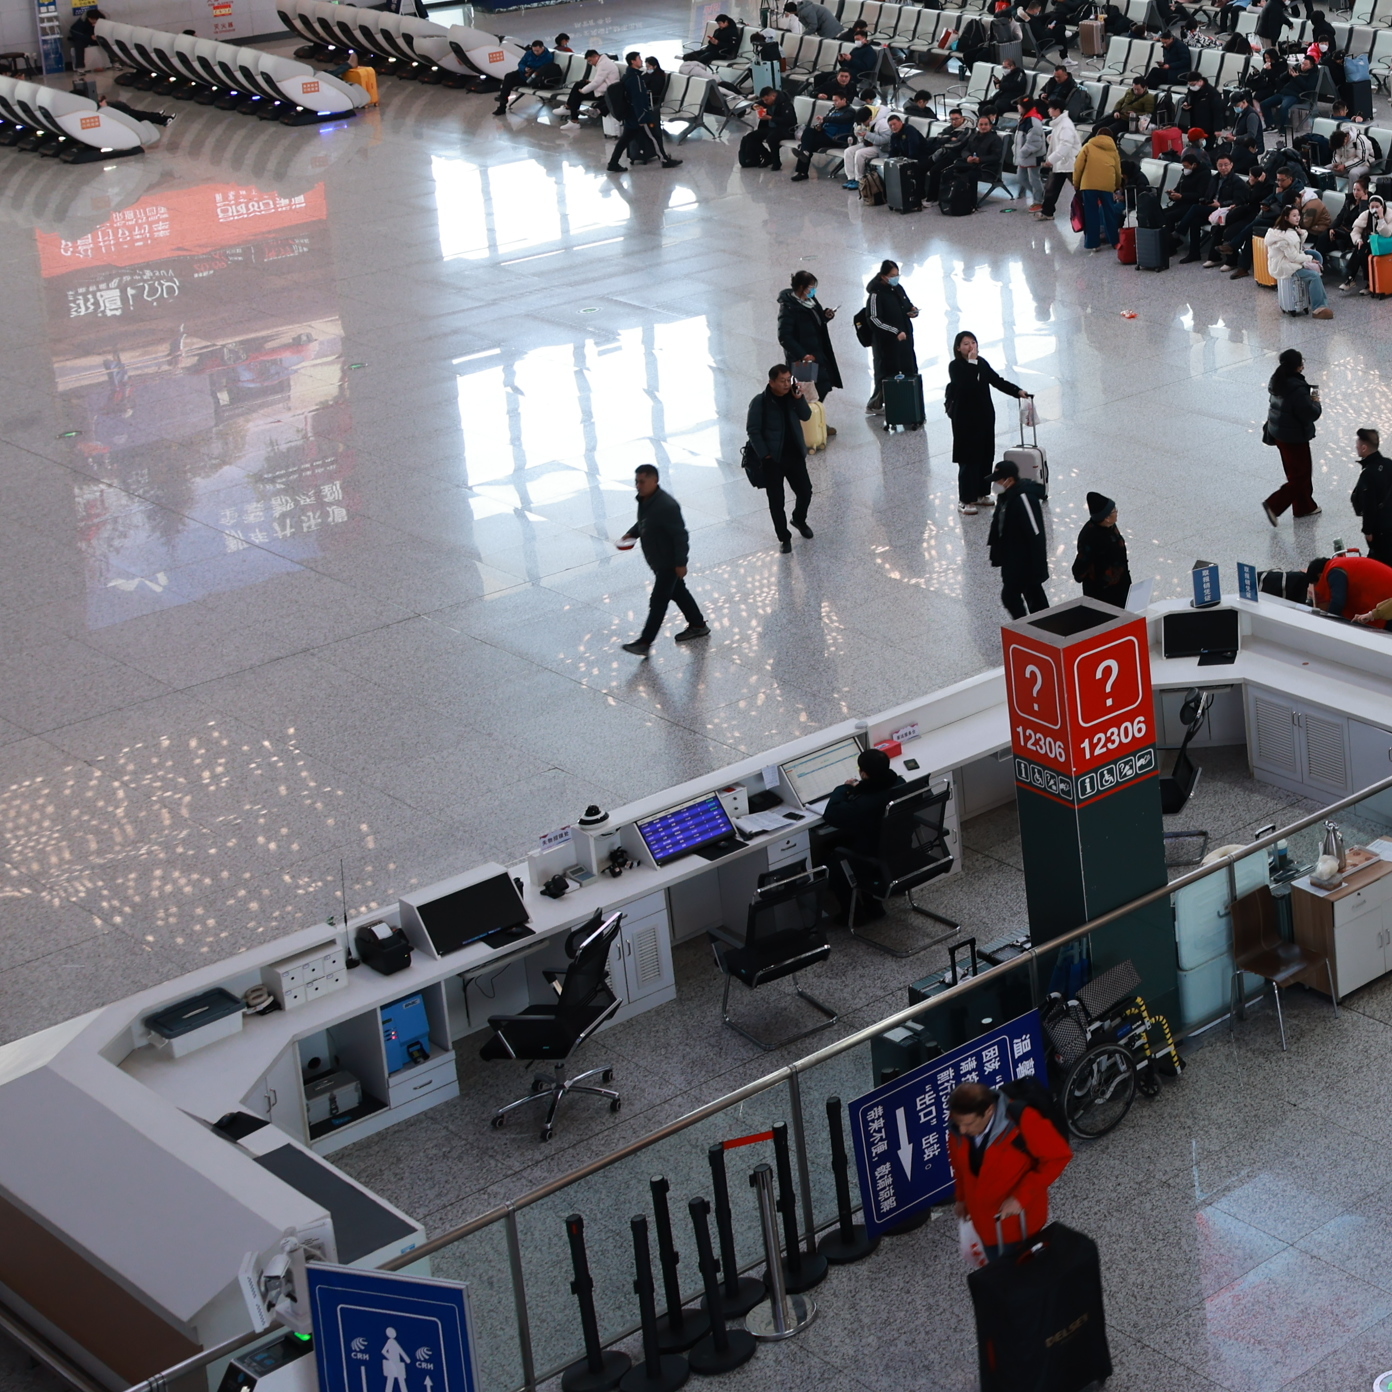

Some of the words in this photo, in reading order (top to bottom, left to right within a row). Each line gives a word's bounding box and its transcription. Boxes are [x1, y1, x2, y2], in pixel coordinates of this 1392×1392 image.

[1201, 569, 1212, 602] 取报销凭证
[1015, 725, 1067, 763] 12306
[1080, 715, 1147, 761] 12306
[1012, 1034, 1034, 1079] 温馨
[864, 1105, 897, 1213] 带来不便，敬请谅解
[351, 1351, 370, 1361] CRH
[416, 1360, 434, 1371] CRH
